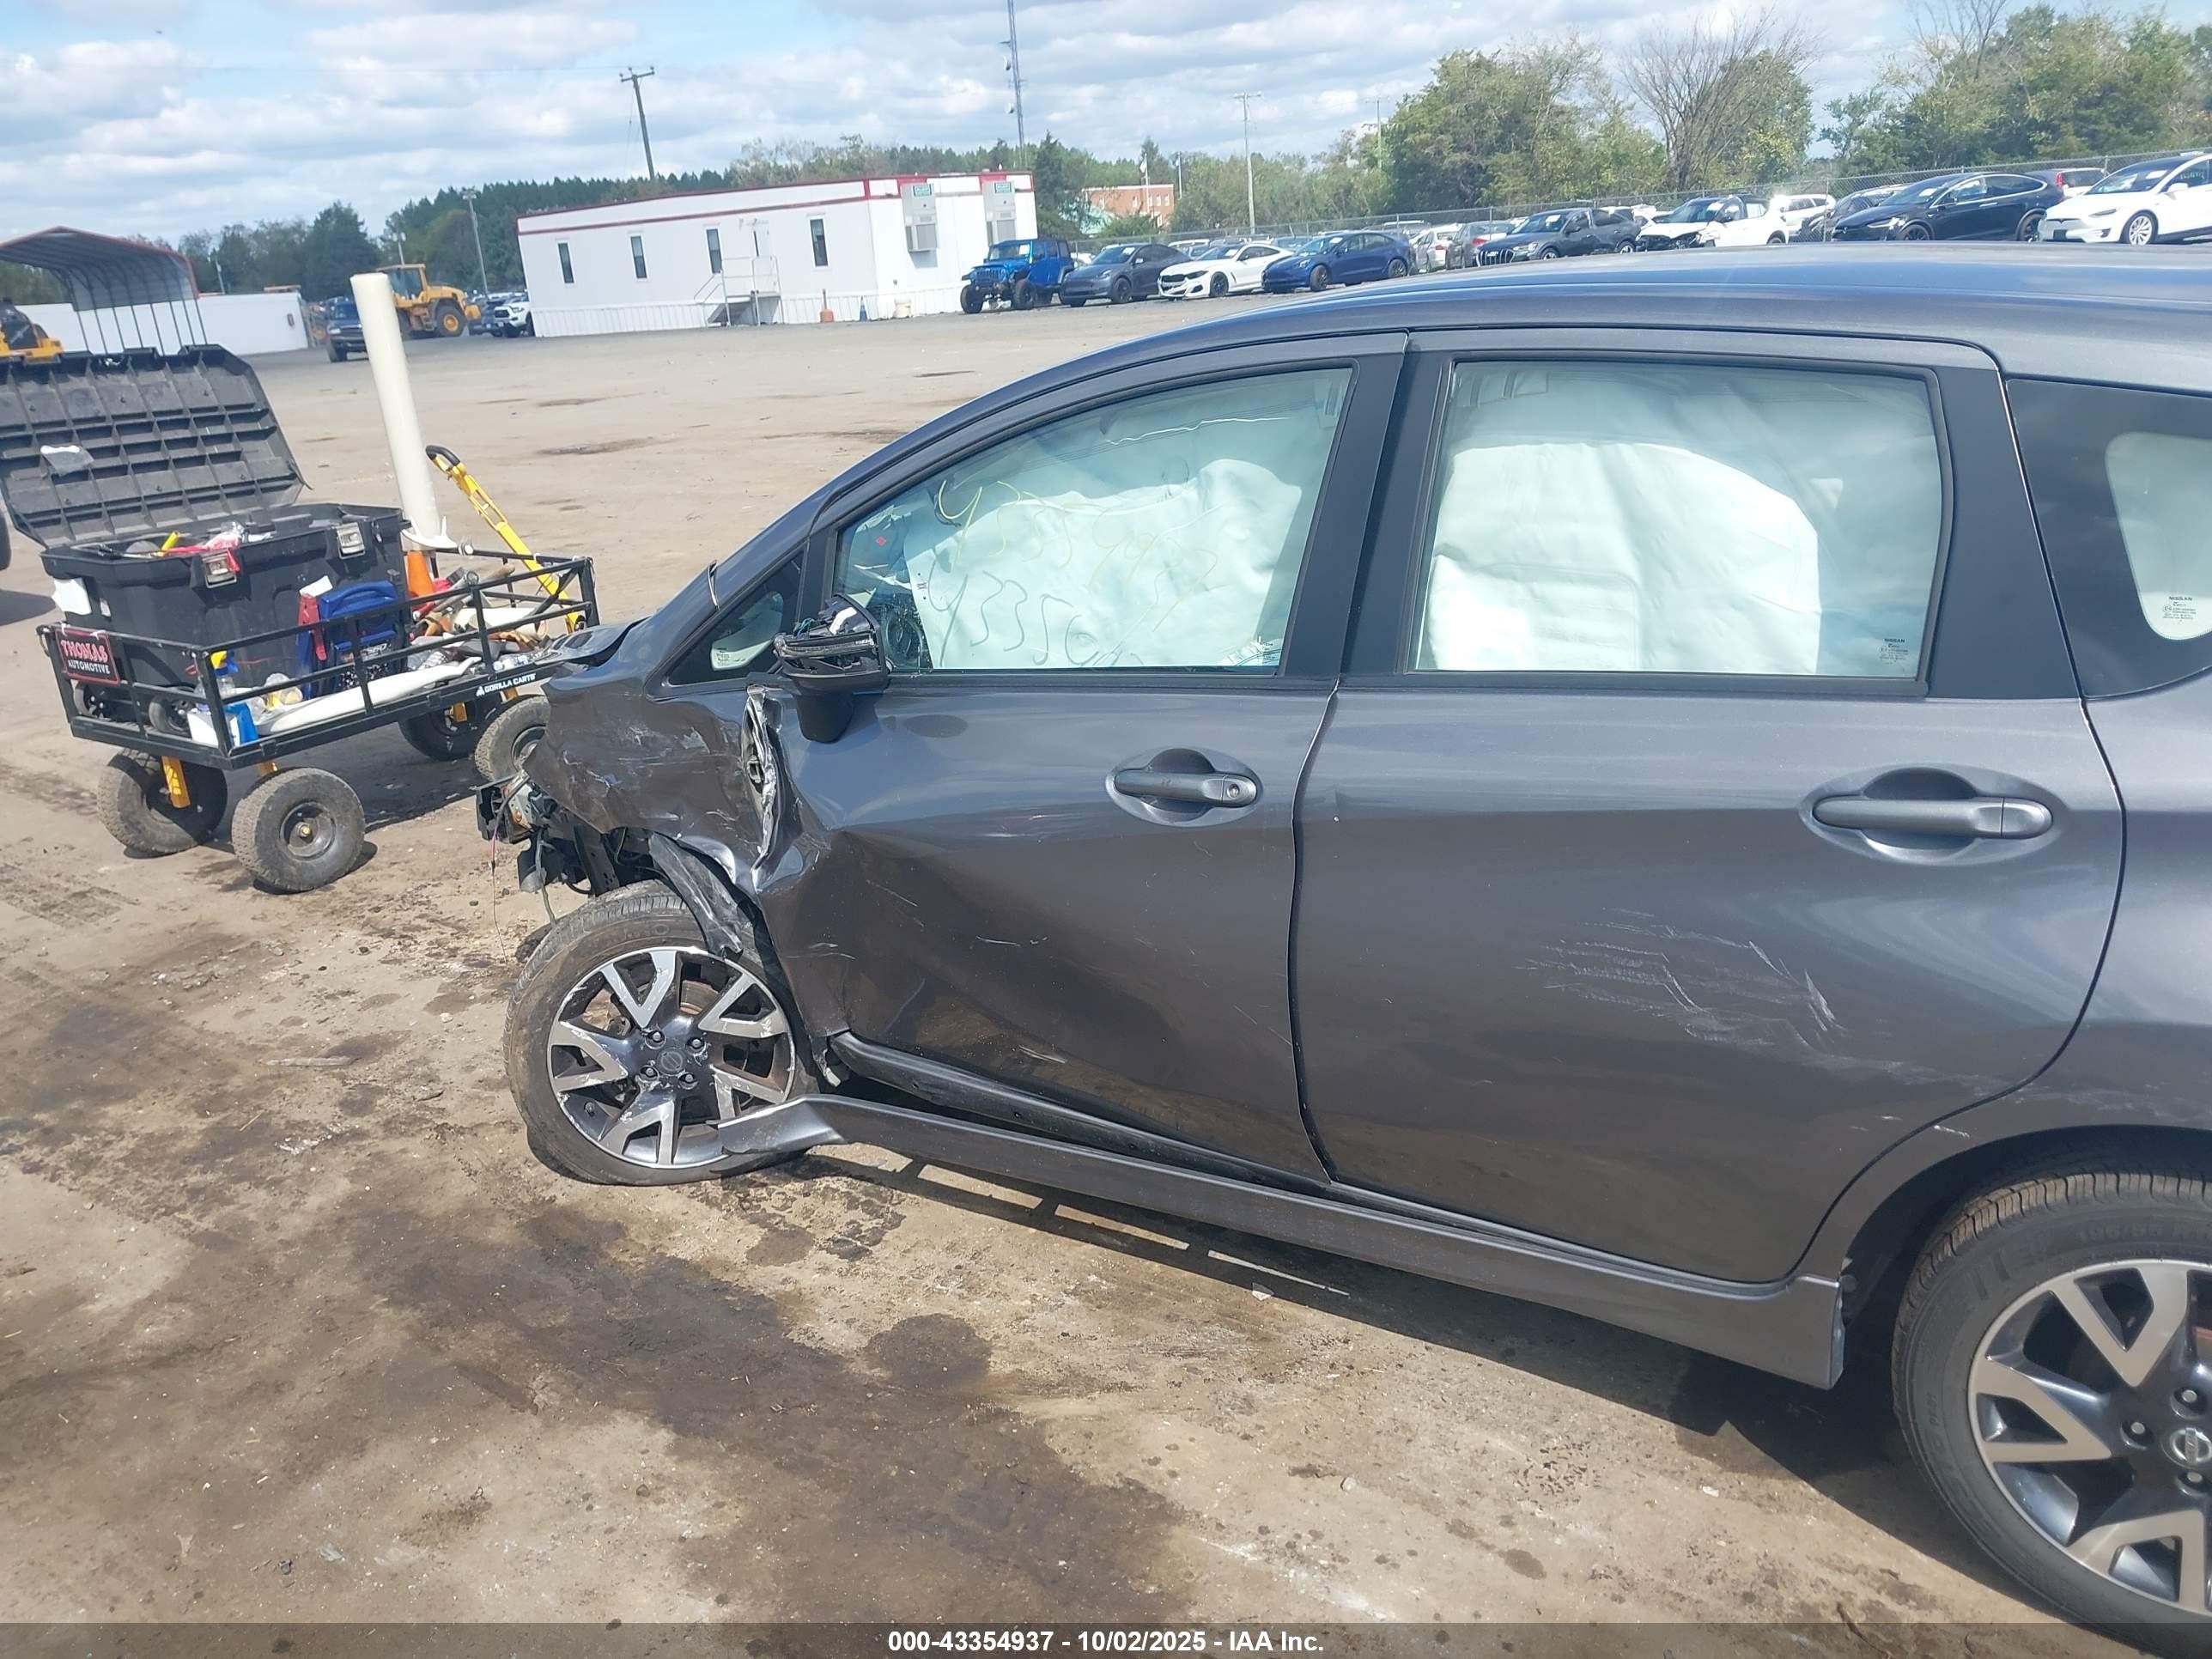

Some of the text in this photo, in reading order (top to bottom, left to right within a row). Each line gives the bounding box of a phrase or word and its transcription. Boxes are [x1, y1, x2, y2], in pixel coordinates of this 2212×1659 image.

[60, 640, 108, 663] THOMAS
[68, 659, 111, 675] AUTOMOTIVE
[484, 680, 513, 693] GORILLA
